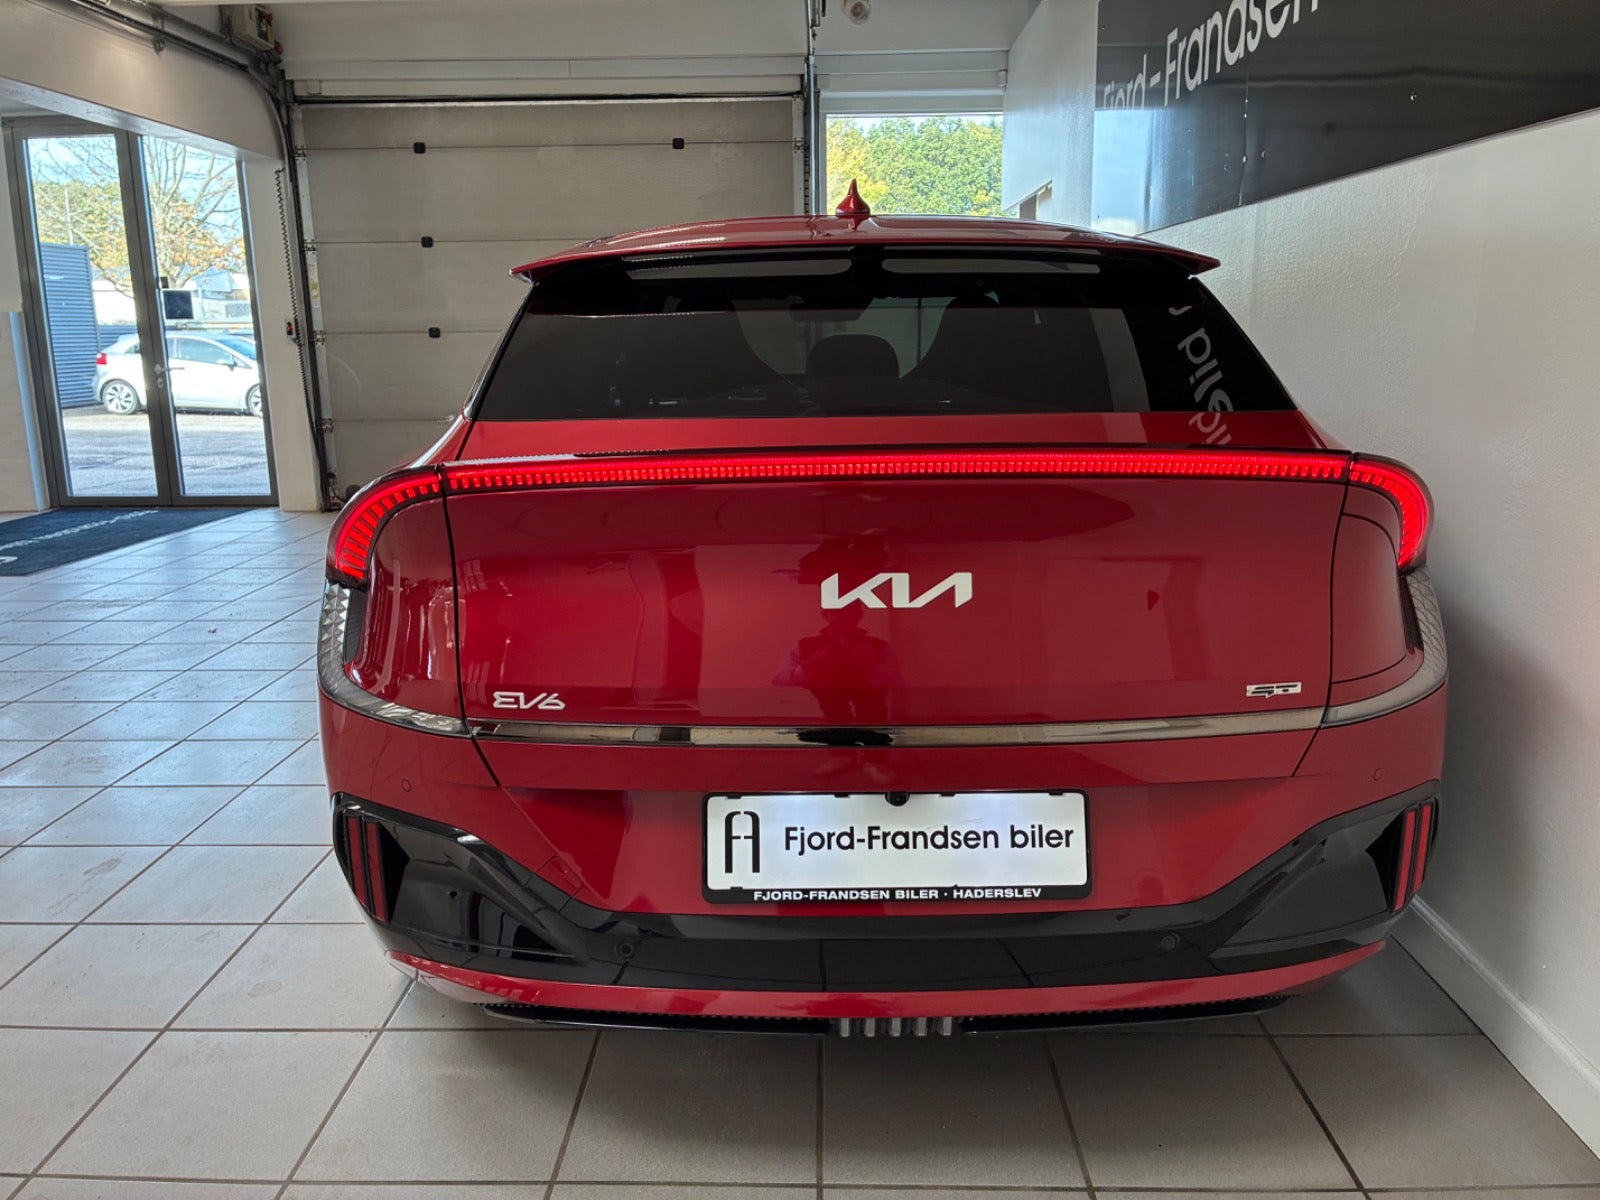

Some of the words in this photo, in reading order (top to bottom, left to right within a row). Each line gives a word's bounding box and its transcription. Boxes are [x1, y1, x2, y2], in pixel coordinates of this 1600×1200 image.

[821, 572, 973, 609] KIA
[493, 691, 566, 710] EV6
[785, 825, 999, 857] Fjord-Frandsen
[1010, 824, 1074, 849] biler
[753, 889, 890, 901] FJORD-FRANDSEN
[894, 888, 939, 900] BILER
[952, 887, 1042, 899] HADERSLEV
